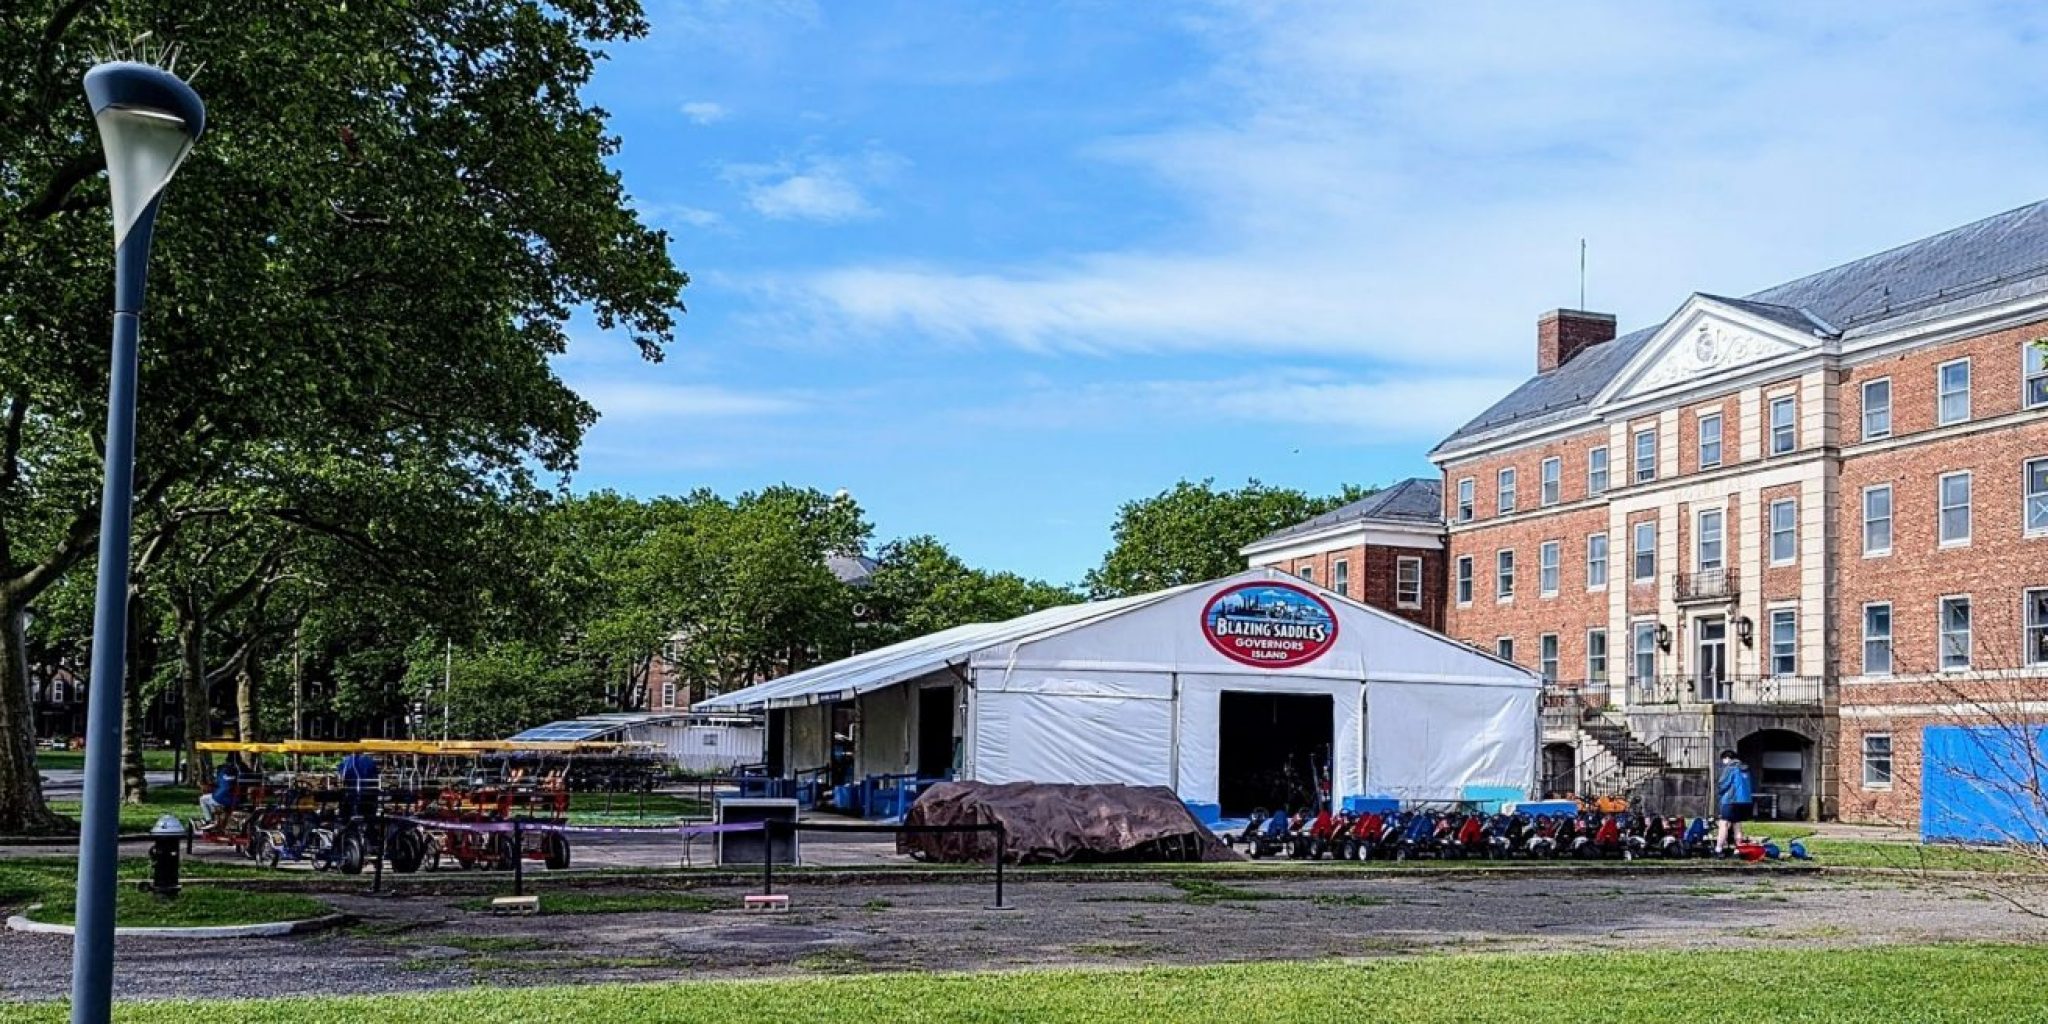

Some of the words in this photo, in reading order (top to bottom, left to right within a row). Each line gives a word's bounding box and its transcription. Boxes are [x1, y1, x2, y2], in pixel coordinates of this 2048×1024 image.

[1216, 617, 1271, 637] BLAZING
[1273, 623, 1325, 642] SADDLES
[1235, 638, 1304, 651] GOVERNORS
[1251, 650, 1288, 660] ISLAND
